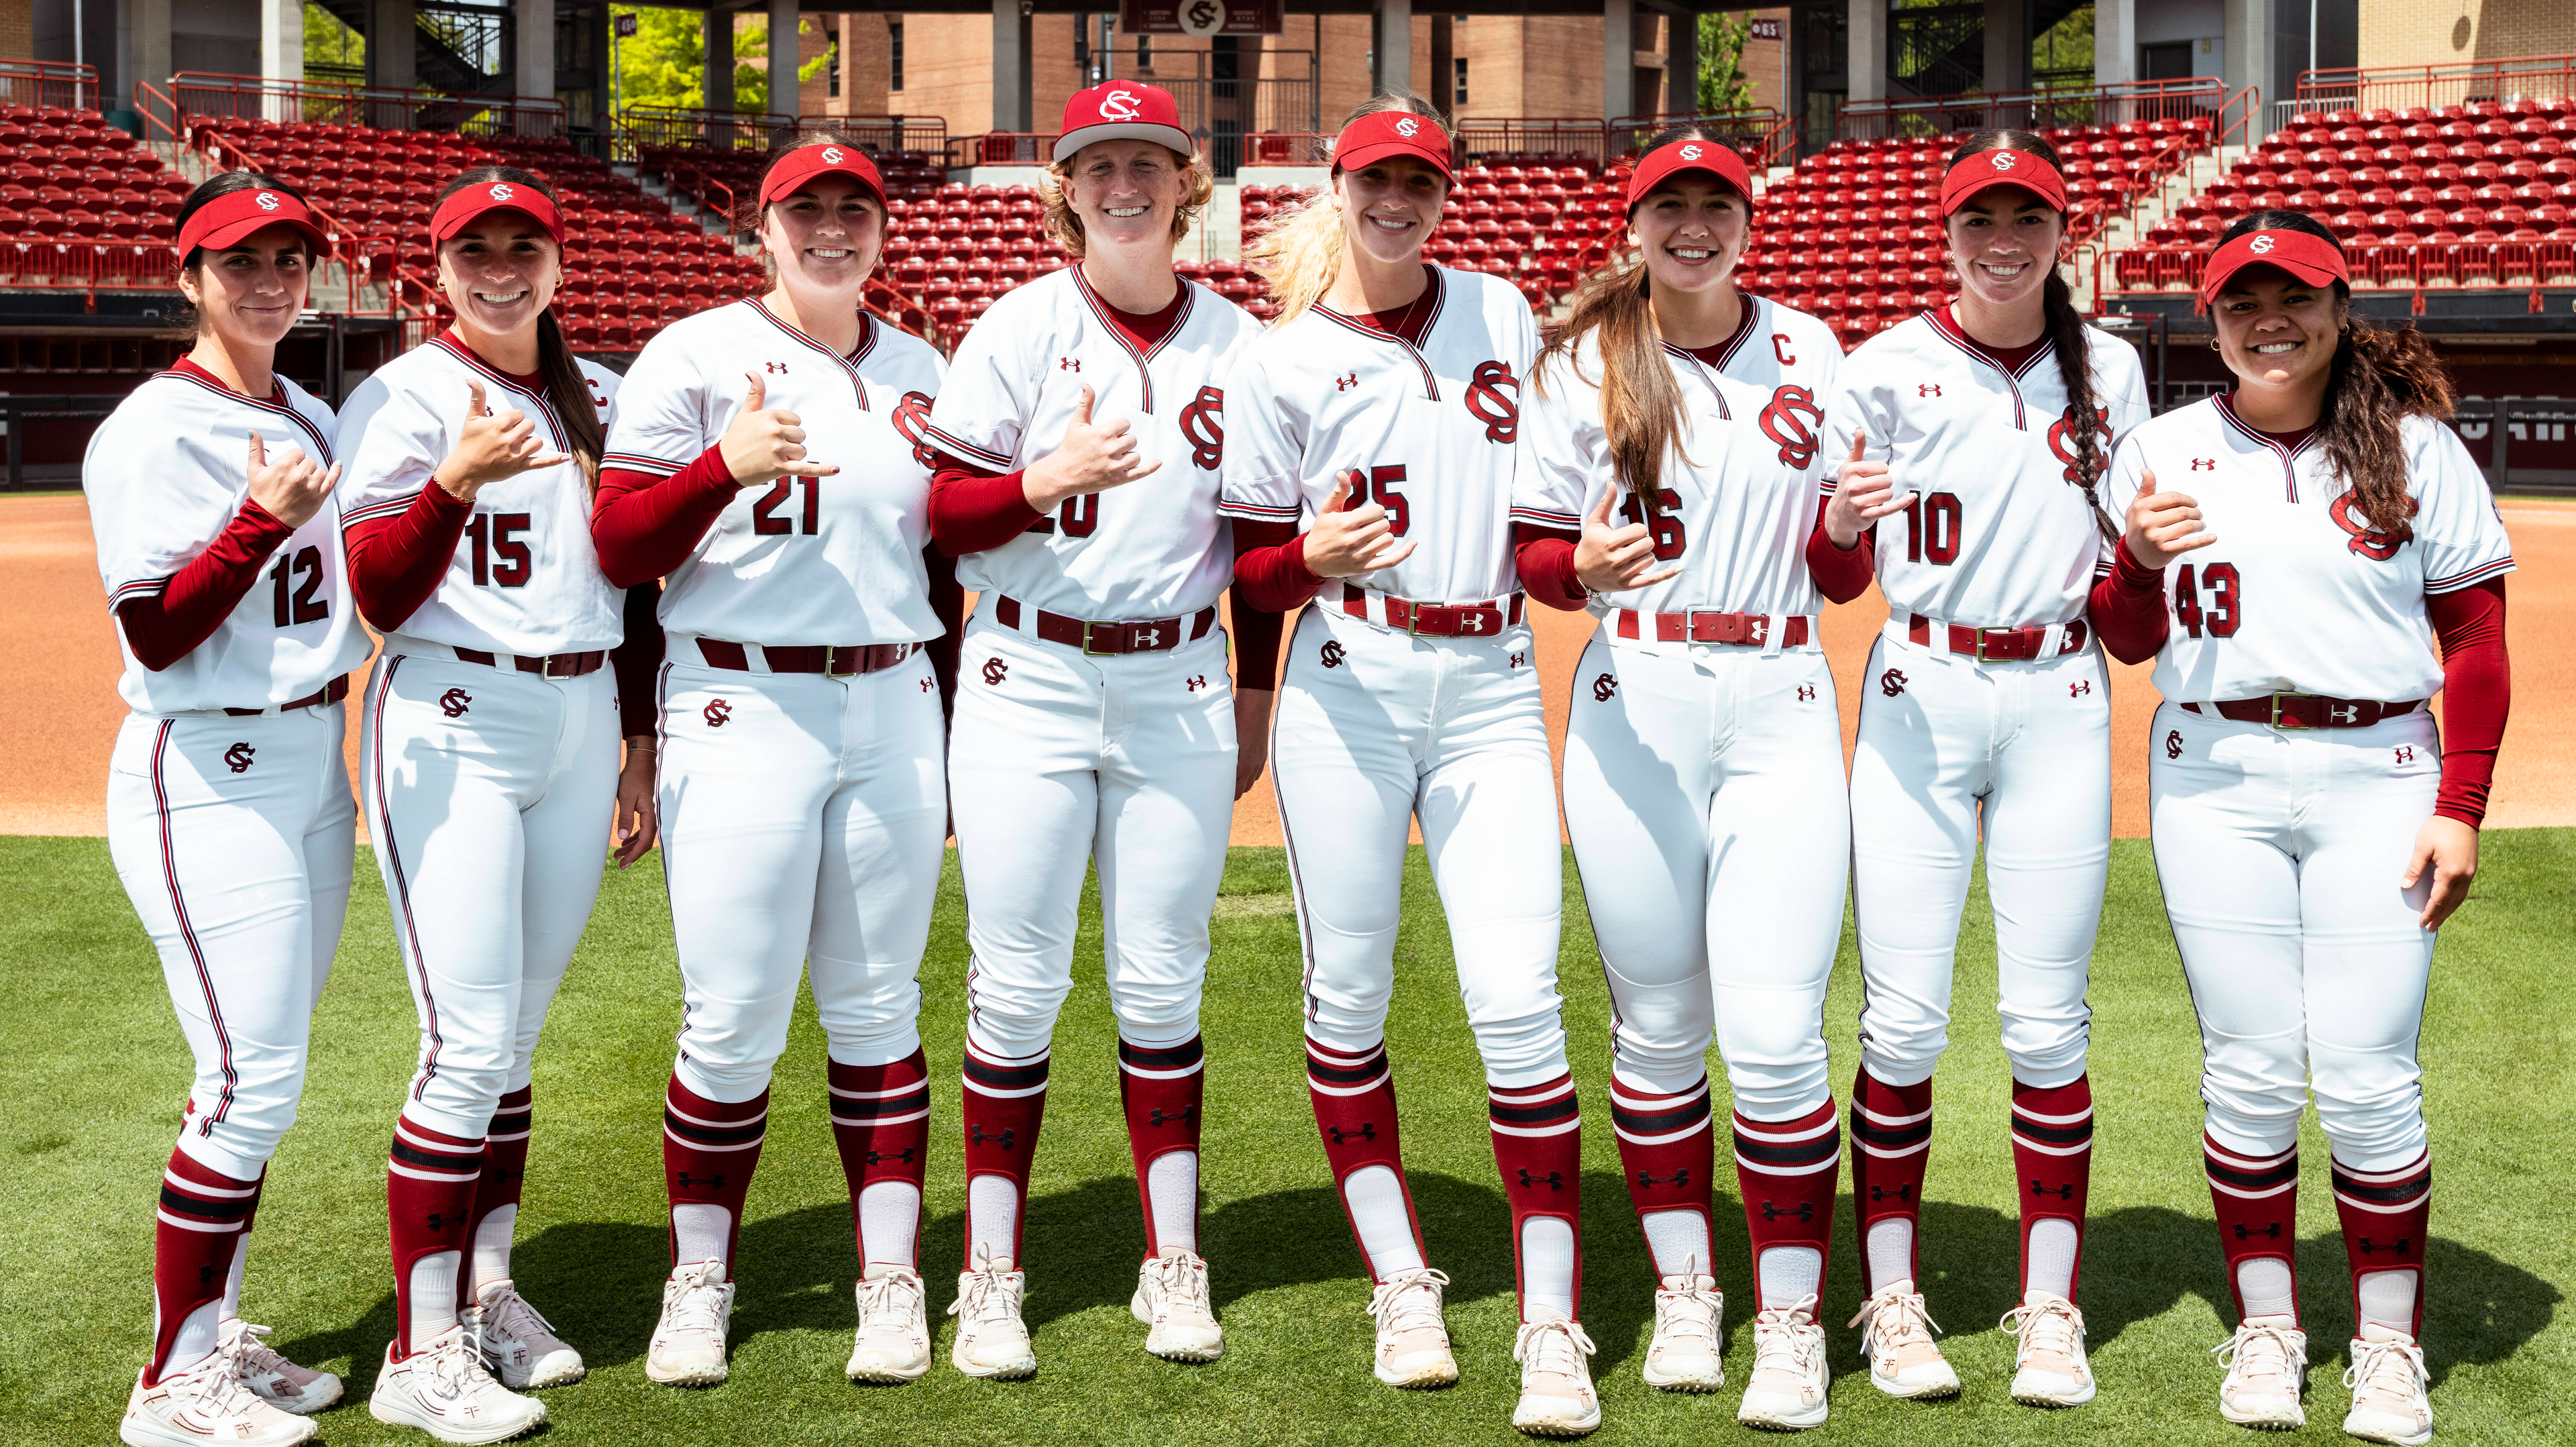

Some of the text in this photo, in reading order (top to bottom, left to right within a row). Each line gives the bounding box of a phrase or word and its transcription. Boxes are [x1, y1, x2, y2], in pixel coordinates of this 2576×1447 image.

[1772, 334, 1796, 366] C
[586, 379, 608, 407] C
[753, 462, 819, 535] 21
[1619, 488, 1686, 561] 16
[1903, 490, 1962, 566] 10
[270, 545, 329, 628] 12
[465, 513, 531, 587] 15
[2176, 562, 2240, 638] 43
